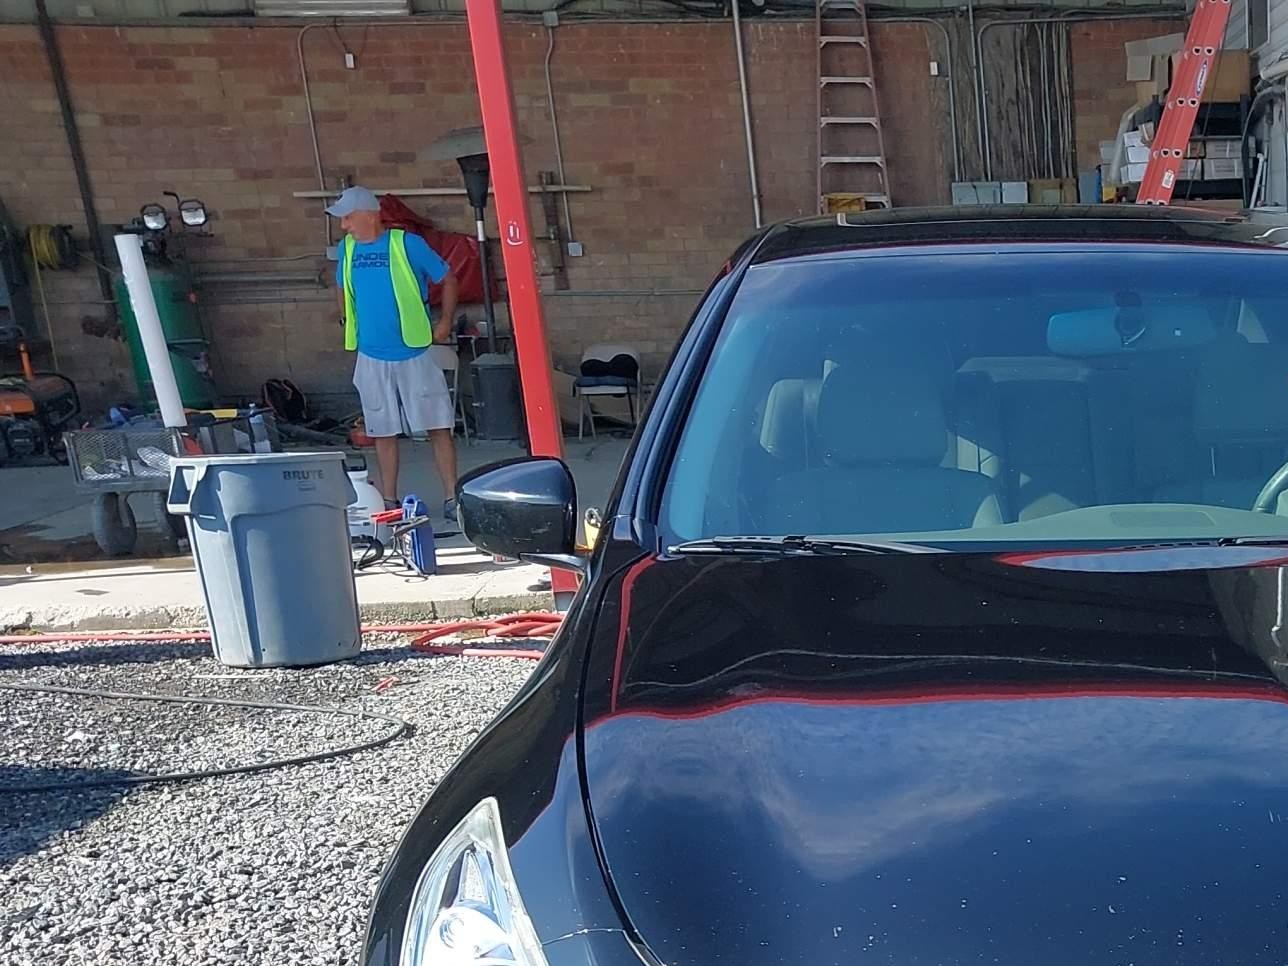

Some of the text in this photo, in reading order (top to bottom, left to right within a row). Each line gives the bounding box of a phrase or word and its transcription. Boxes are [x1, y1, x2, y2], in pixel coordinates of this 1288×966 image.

[352, 252, 389, 262] UNDE
[352, 261, 390, 269] ARMOU
[283, 469, 325, 481] BRUTE
